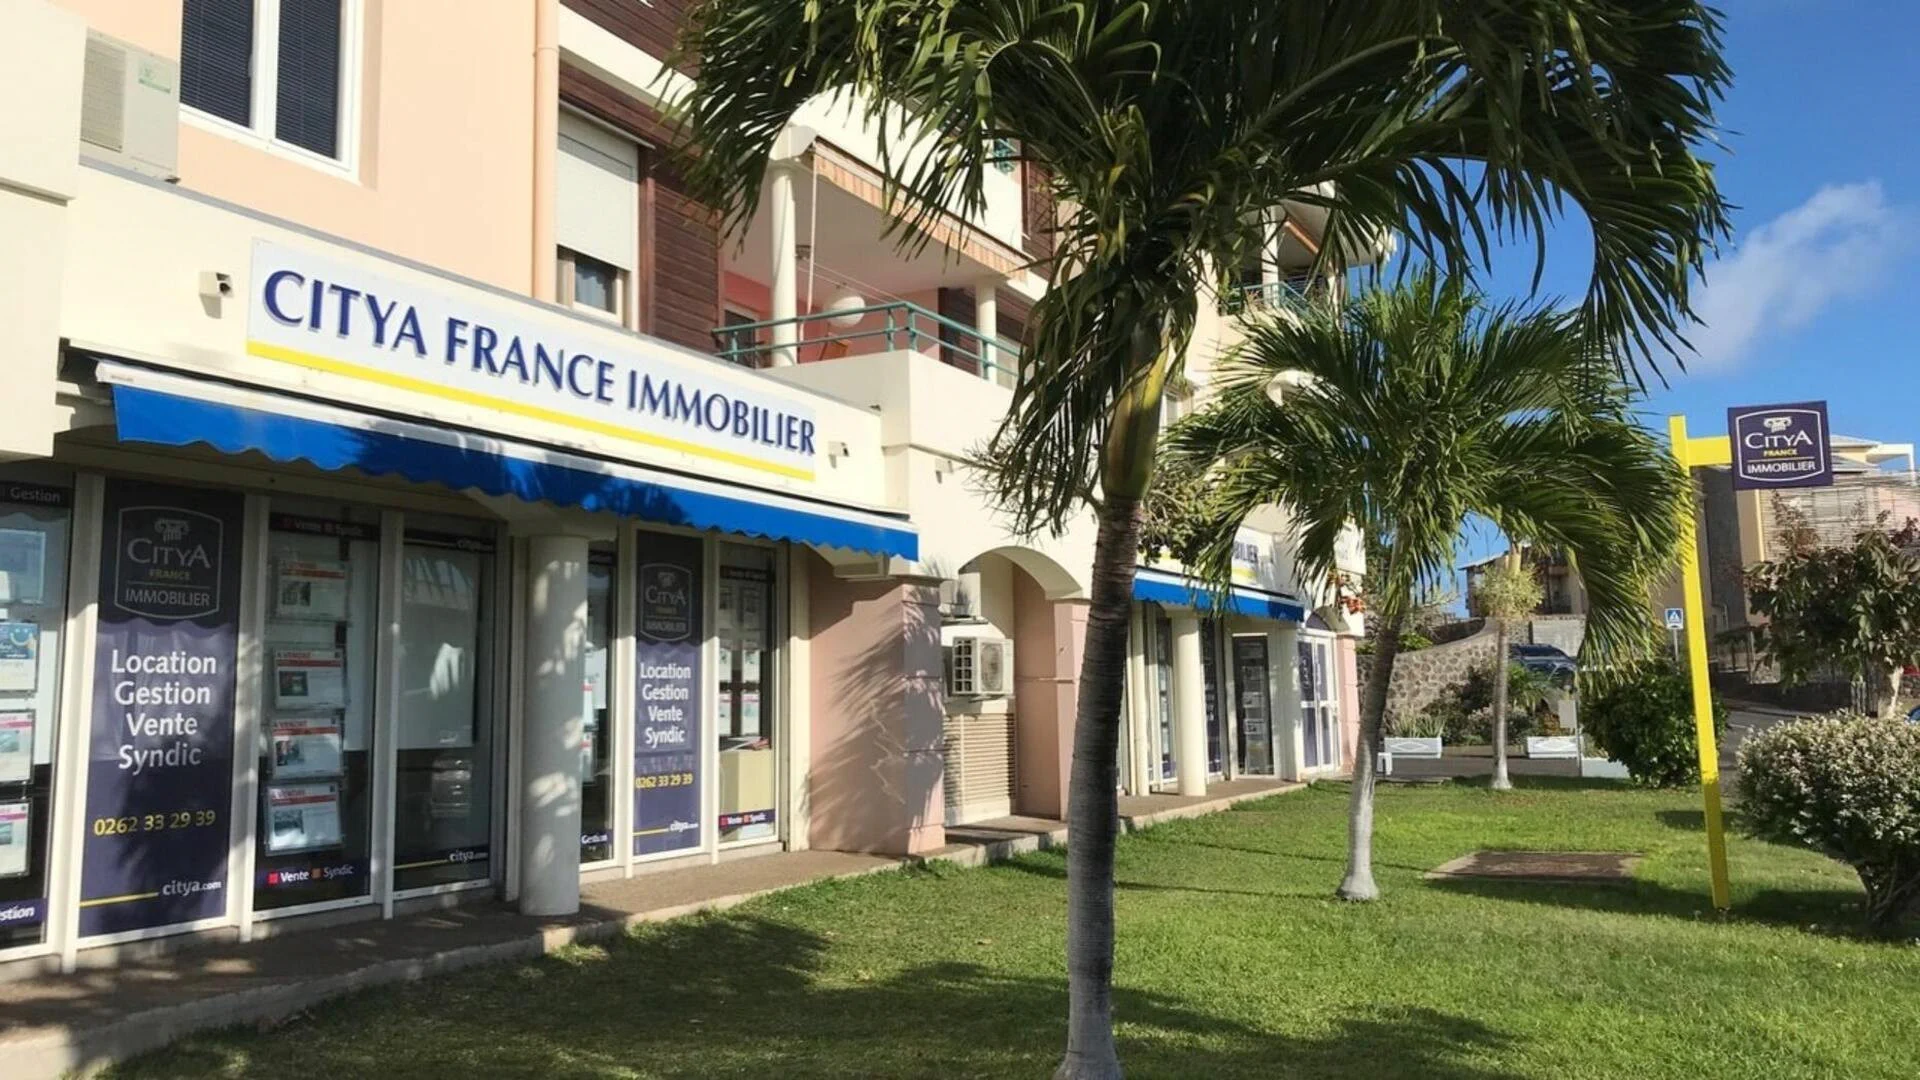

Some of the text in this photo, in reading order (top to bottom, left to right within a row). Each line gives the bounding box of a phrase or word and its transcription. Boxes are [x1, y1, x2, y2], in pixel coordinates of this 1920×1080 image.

[264, 270, 817, 456] CITYA FRANCE IMMOBILIER
[1744, 430, 1813, 450] CITYA
[1763, 449, 1798, 457] FRANCE
[1747, 461, 1816, 474] IMMOBILIER
[127, 538, 212, 569] CITYA
[149, 568, 191, 582] FRANCE
[124, 588, 211, 607] IMMOBILIER
[111, 650, 217, 675] Location
[640, 662, 691, 680] Location
[114, 681, 211, 706] Gestion
[642, 684, 689, 702] Gestion
[648, 706, 683, 723] Vente
[126, 713, 198, 738] Vente
[645, 726, 686, 749] Syndic
[118, 741, 202, 775] Syndic
[658, 775, 670, 788] 33
[671, 774, 682, 787] 29
[683, 773, 693, 786] 39
[93, 809, 217, 837] 0262 33 29 39
[280, 863, 354, 883] Vente Syndic
[162, 878, 222, 898] citya.com
